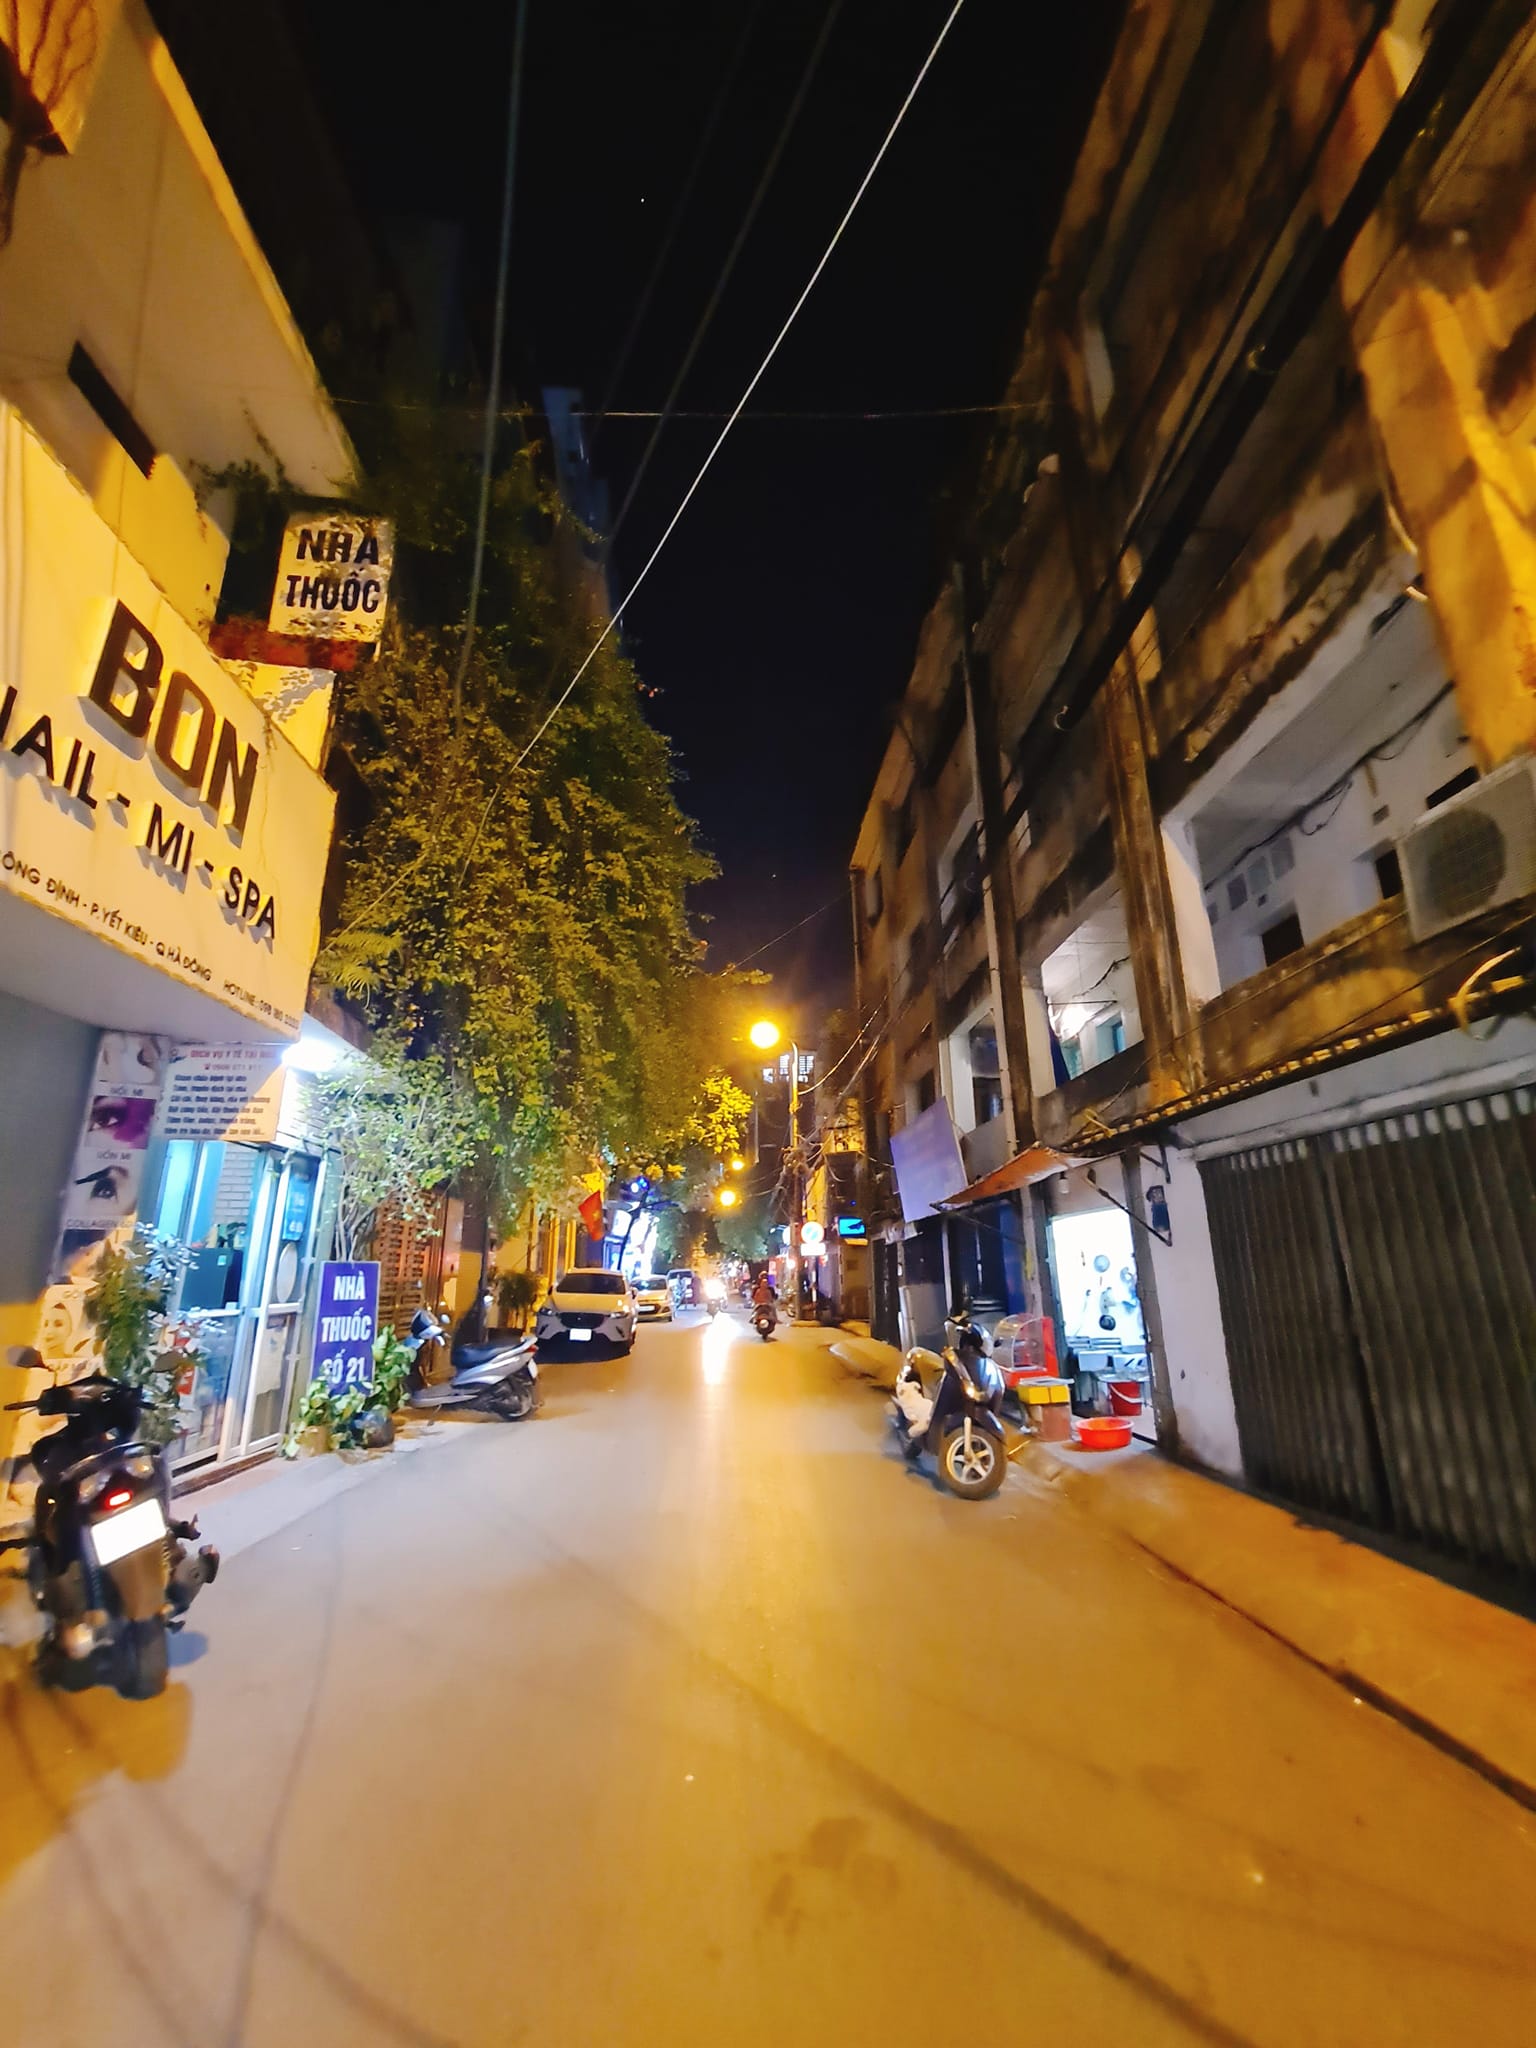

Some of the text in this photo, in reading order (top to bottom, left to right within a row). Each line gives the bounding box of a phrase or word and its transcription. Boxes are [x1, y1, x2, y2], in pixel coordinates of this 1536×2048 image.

[286, 568, 381, 613] THUỐC
[89, 599, 259, 833] BON
[0, 850, 41, 885] ÔNG
[145, 802, 195, 875] MI
[225, 866, 275, 941] SPA
[333, 1271, 366, 1301] NHÀ
[321, 1307, 372, 1343] THUỐC
